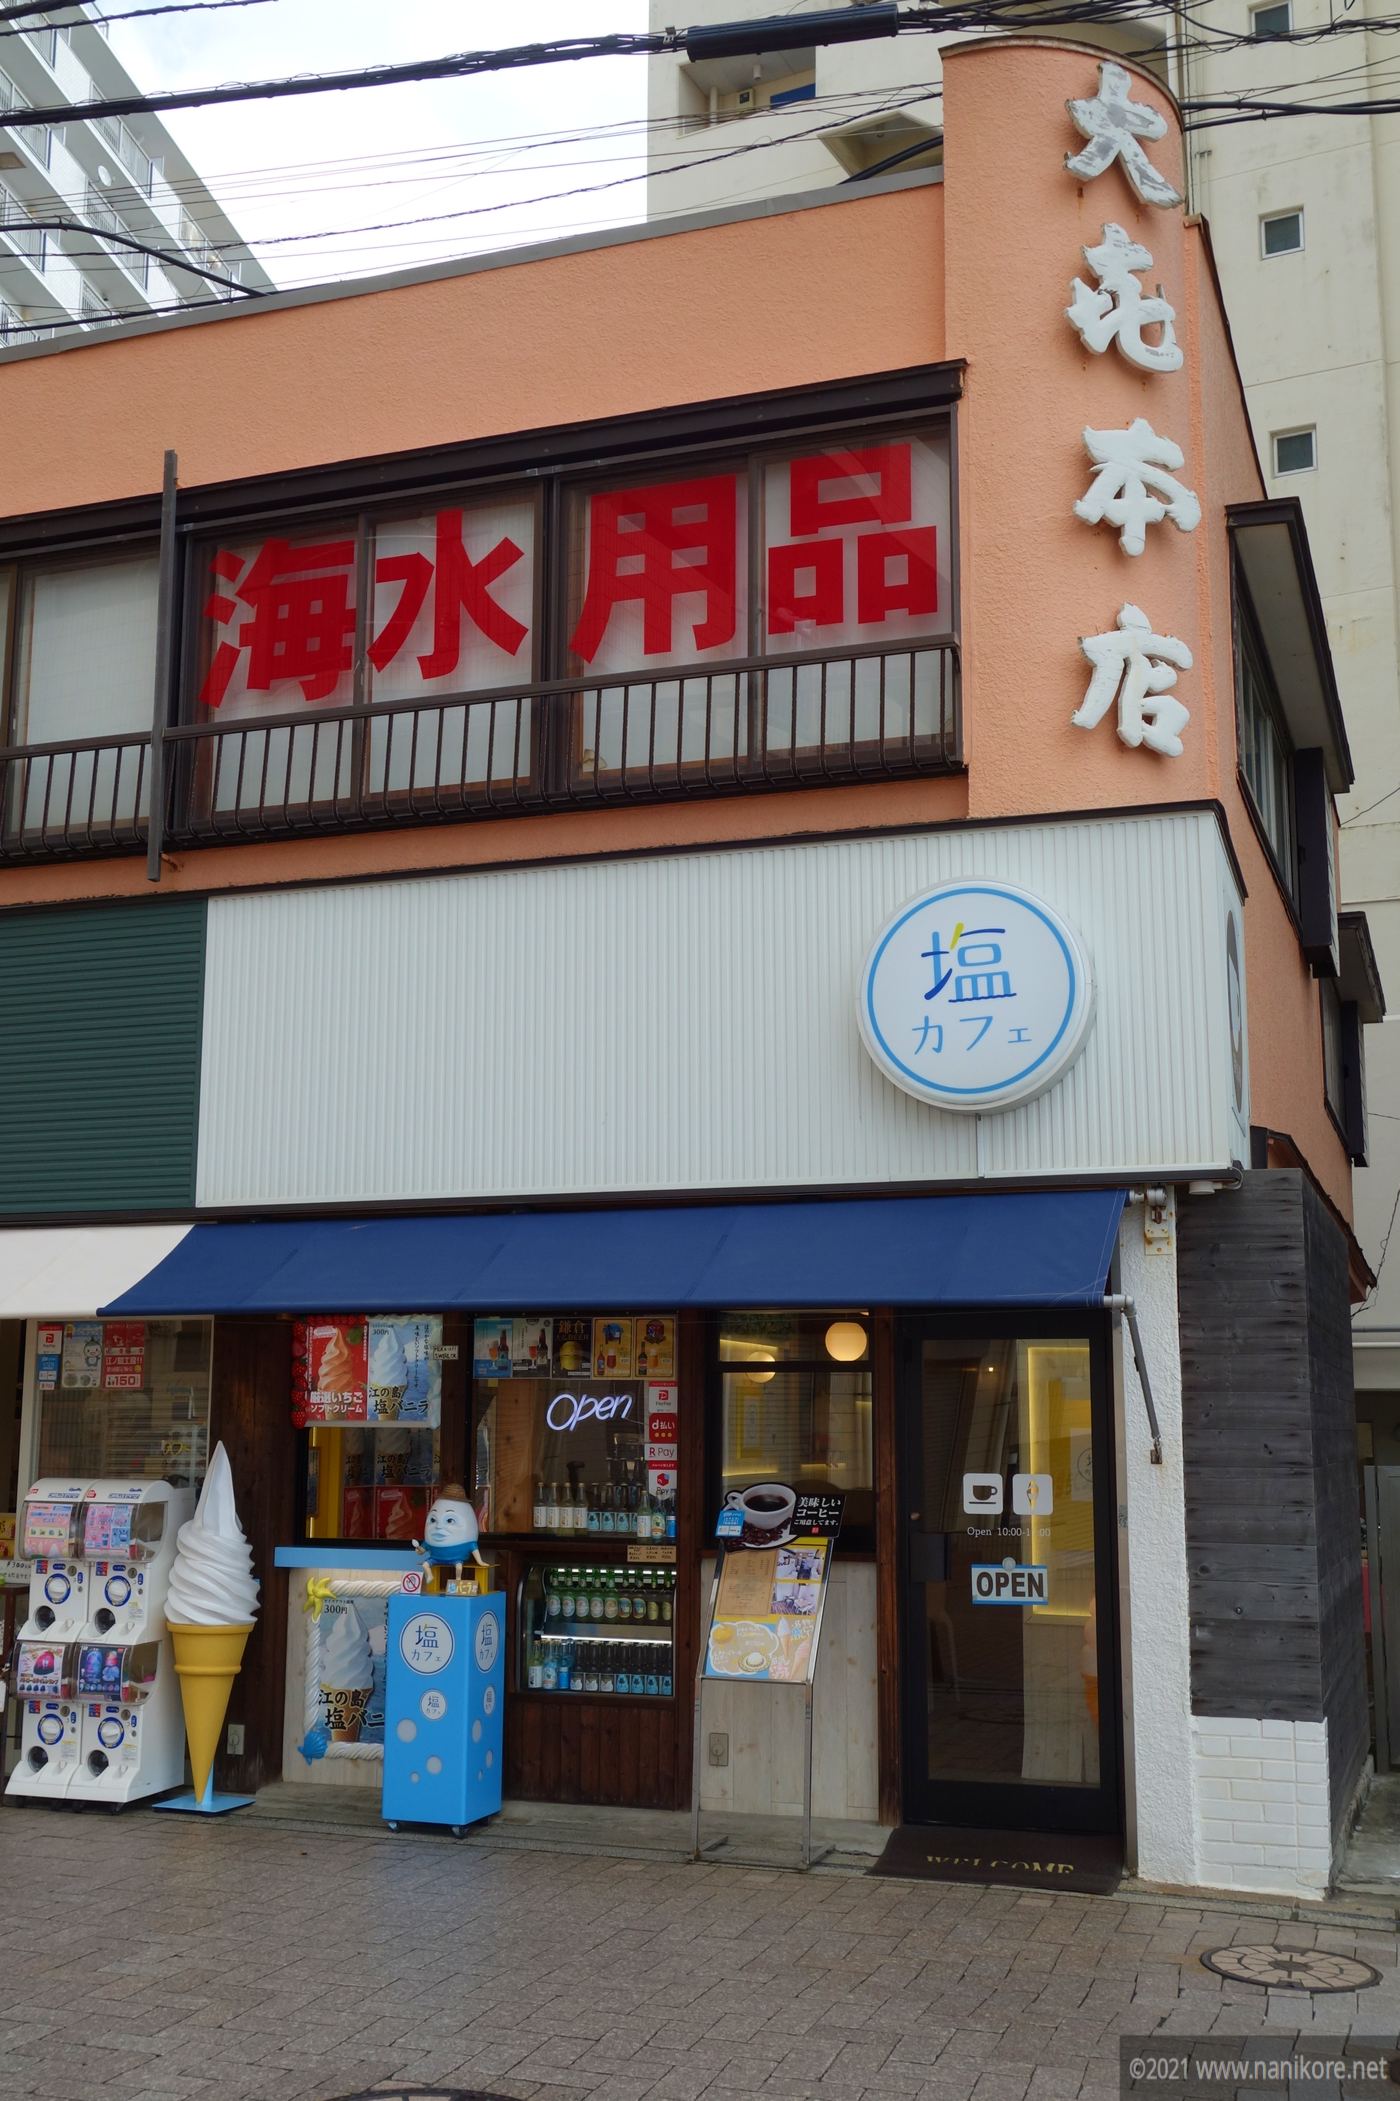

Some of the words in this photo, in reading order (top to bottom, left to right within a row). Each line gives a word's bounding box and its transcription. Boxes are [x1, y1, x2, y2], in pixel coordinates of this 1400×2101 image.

[199, 443, 939, 709] 海水用品
[920, 921, 1017, 1003] 塩
[911, 1014, 1033, 1056] カフェ
[310, 1391, 363, 1404] 厳選いちご
[368, 1387, 404, 1398] 江の島
[310, 1404, 363, 1413] ソフトクリーム
[373, 1399, 430, 1415] 塩バニラ
[546, 1393, 633, 1431] Open
[651, 1421, 675, 1430] d払い
[658, 1447, 675, 1458] Pay
[799, 1496, 841, 1508] 美味しい
[796, 1508, 840, 1519] コーヒー
[967, 1526, 992, 1537] Open
[976, 1571, 1044, 1598] OPEN
[324, 1604, 348, 1614] 300円
[415, 1623, 439, 1648] 塩
[481, 1623, 493, 1646] 塩
[411, 1649, 442, 1662] カフェ
[318, 1689, 370, 1708] 江の島
